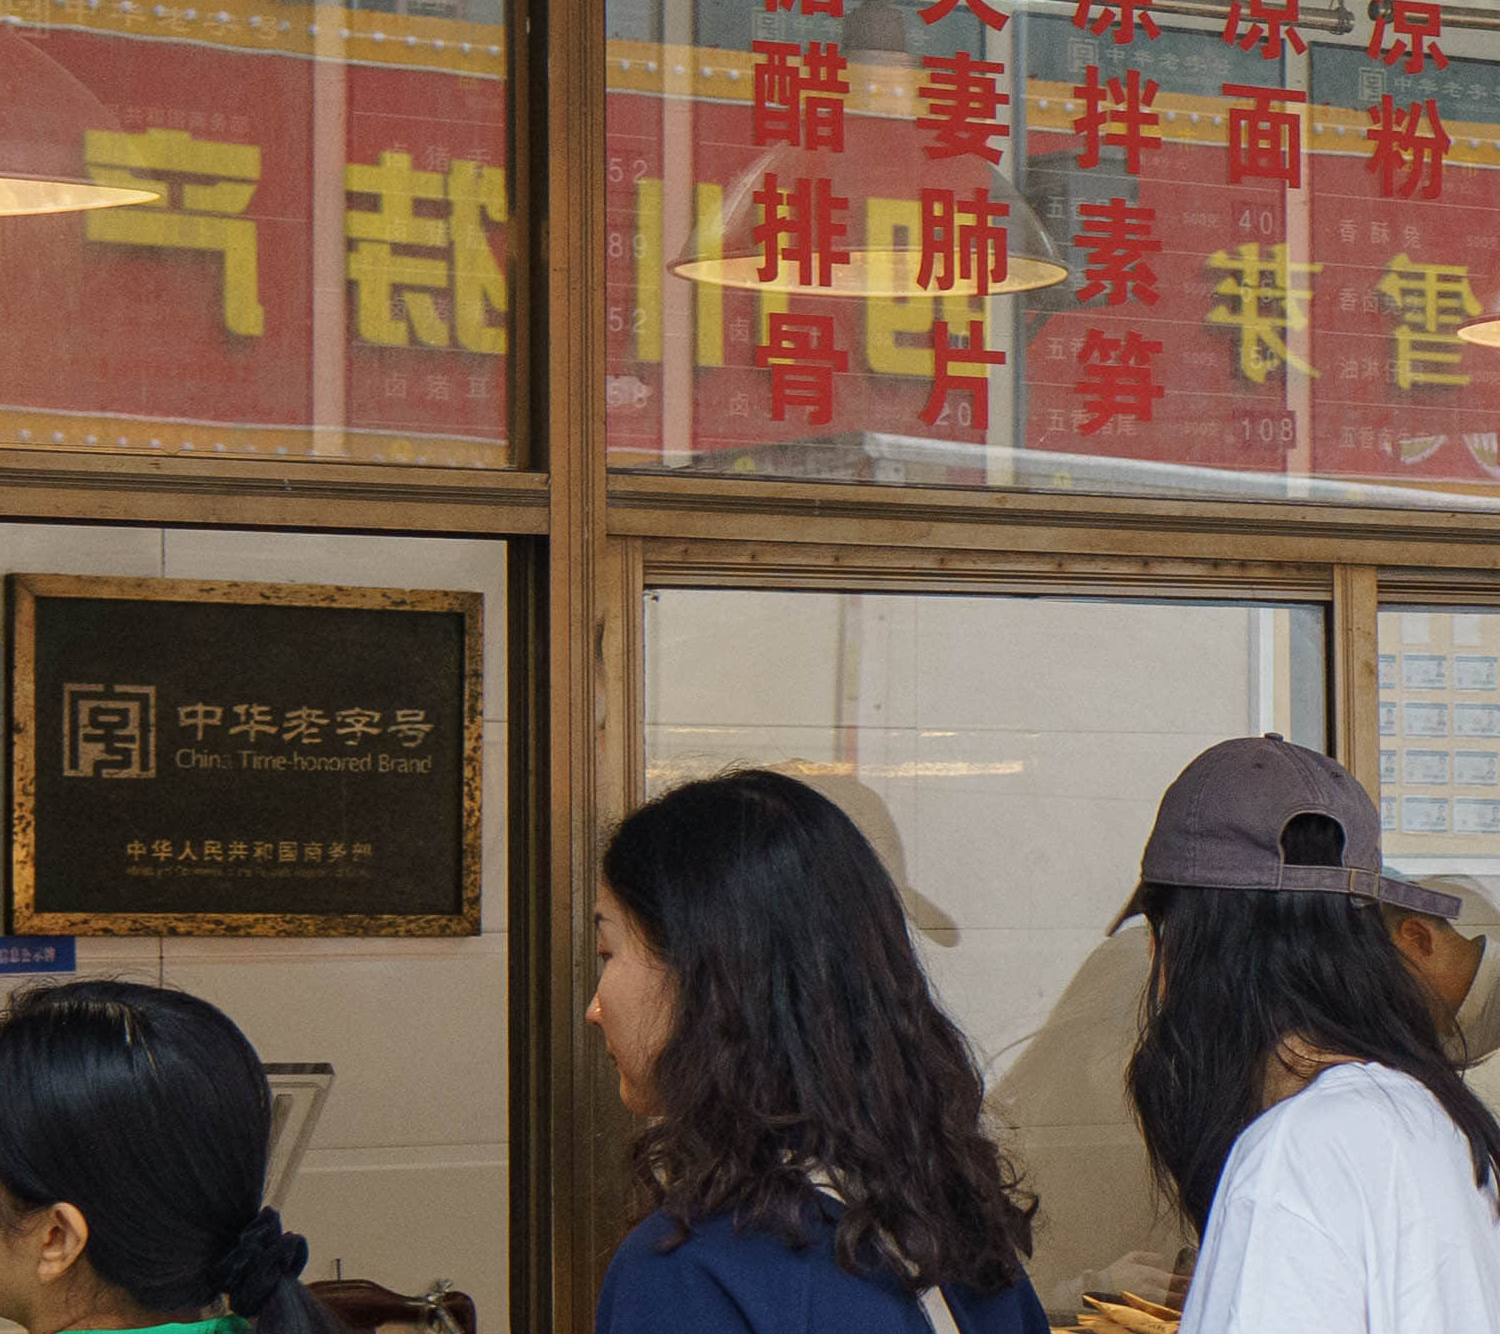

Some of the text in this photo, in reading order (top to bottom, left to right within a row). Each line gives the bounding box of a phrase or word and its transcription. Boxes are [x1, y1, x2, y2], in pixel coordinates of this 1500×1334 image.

[1238, 209, 1274, 236] 40
[1241, 417, 1294, 442] 108
[176, 701, 436, 748] 中华老字号
[239, 749, 373, 774] Time-honored
[378, 753, 433, 775] Brand
